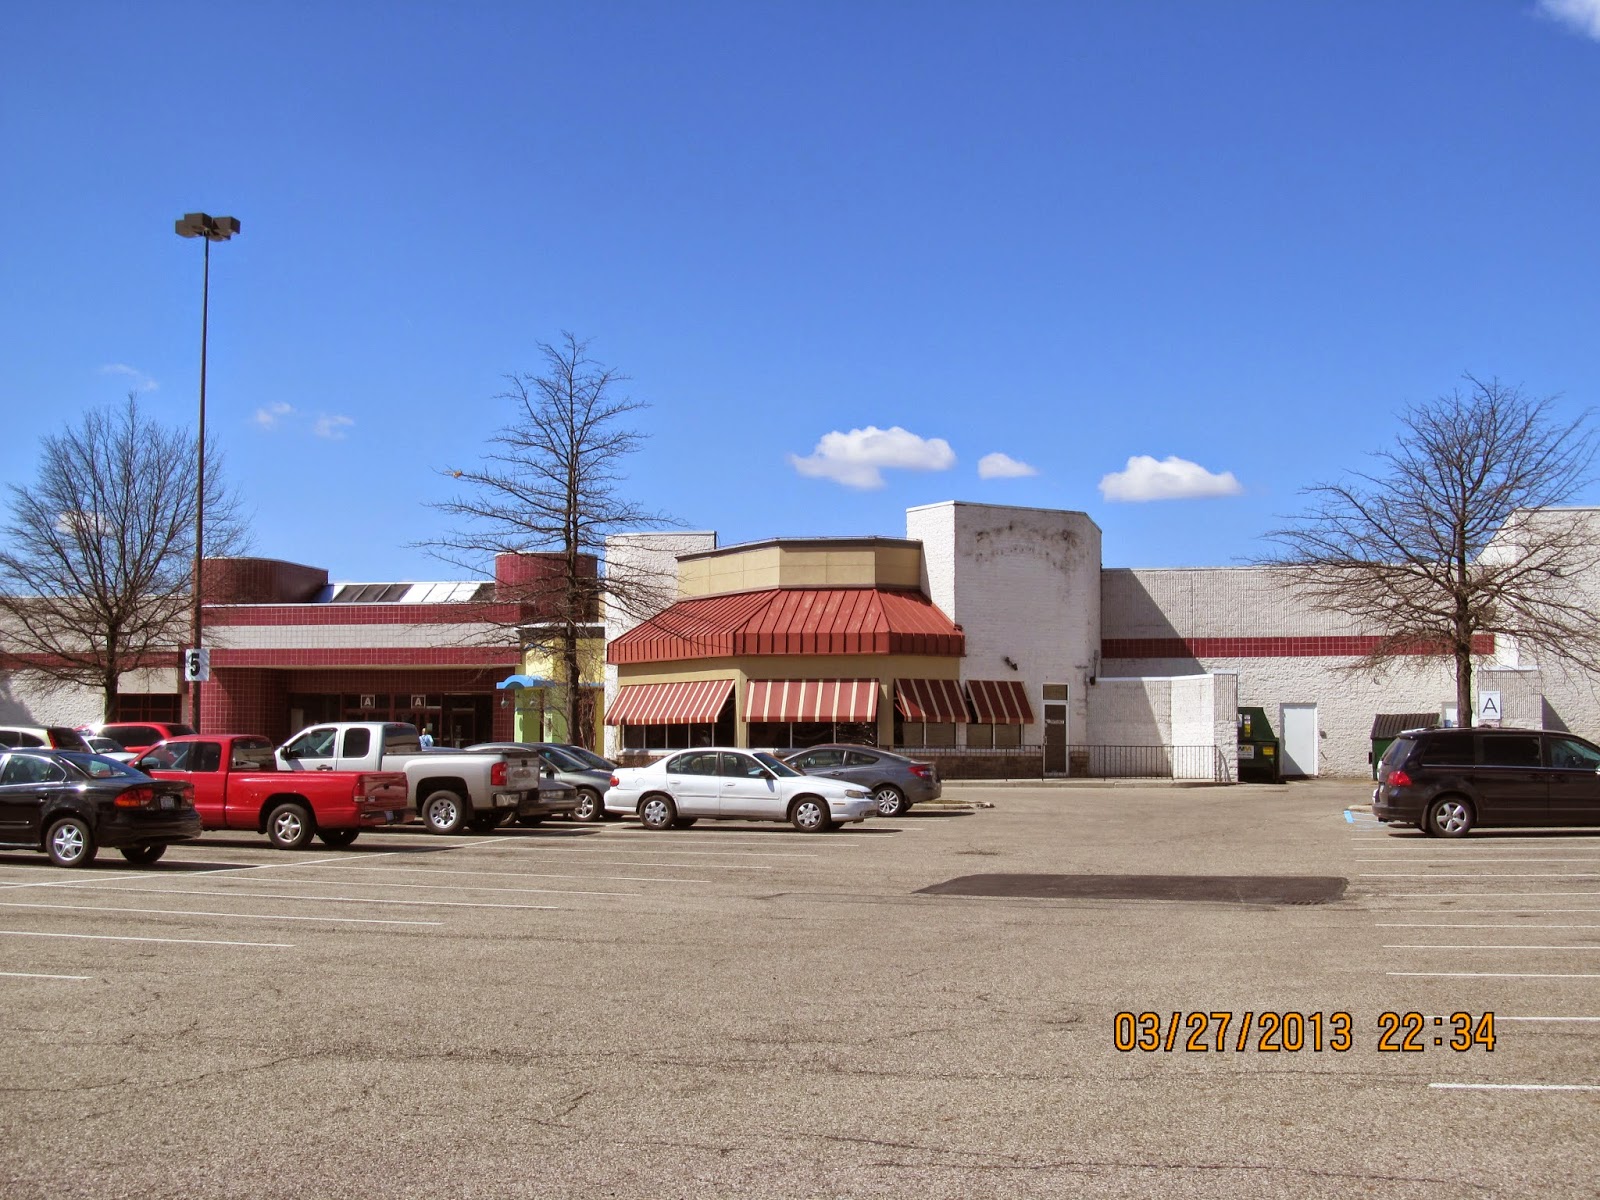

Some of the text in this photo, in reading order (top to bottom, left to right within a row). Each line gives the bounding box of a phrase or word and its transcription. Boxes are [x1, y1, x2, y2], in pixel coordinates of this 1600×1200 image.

[190, 652, 201, 677] 5
[364, 697, 372, 706] A
[414, 697, 422, 706] A
[1482, 697, 1498, 713] A
